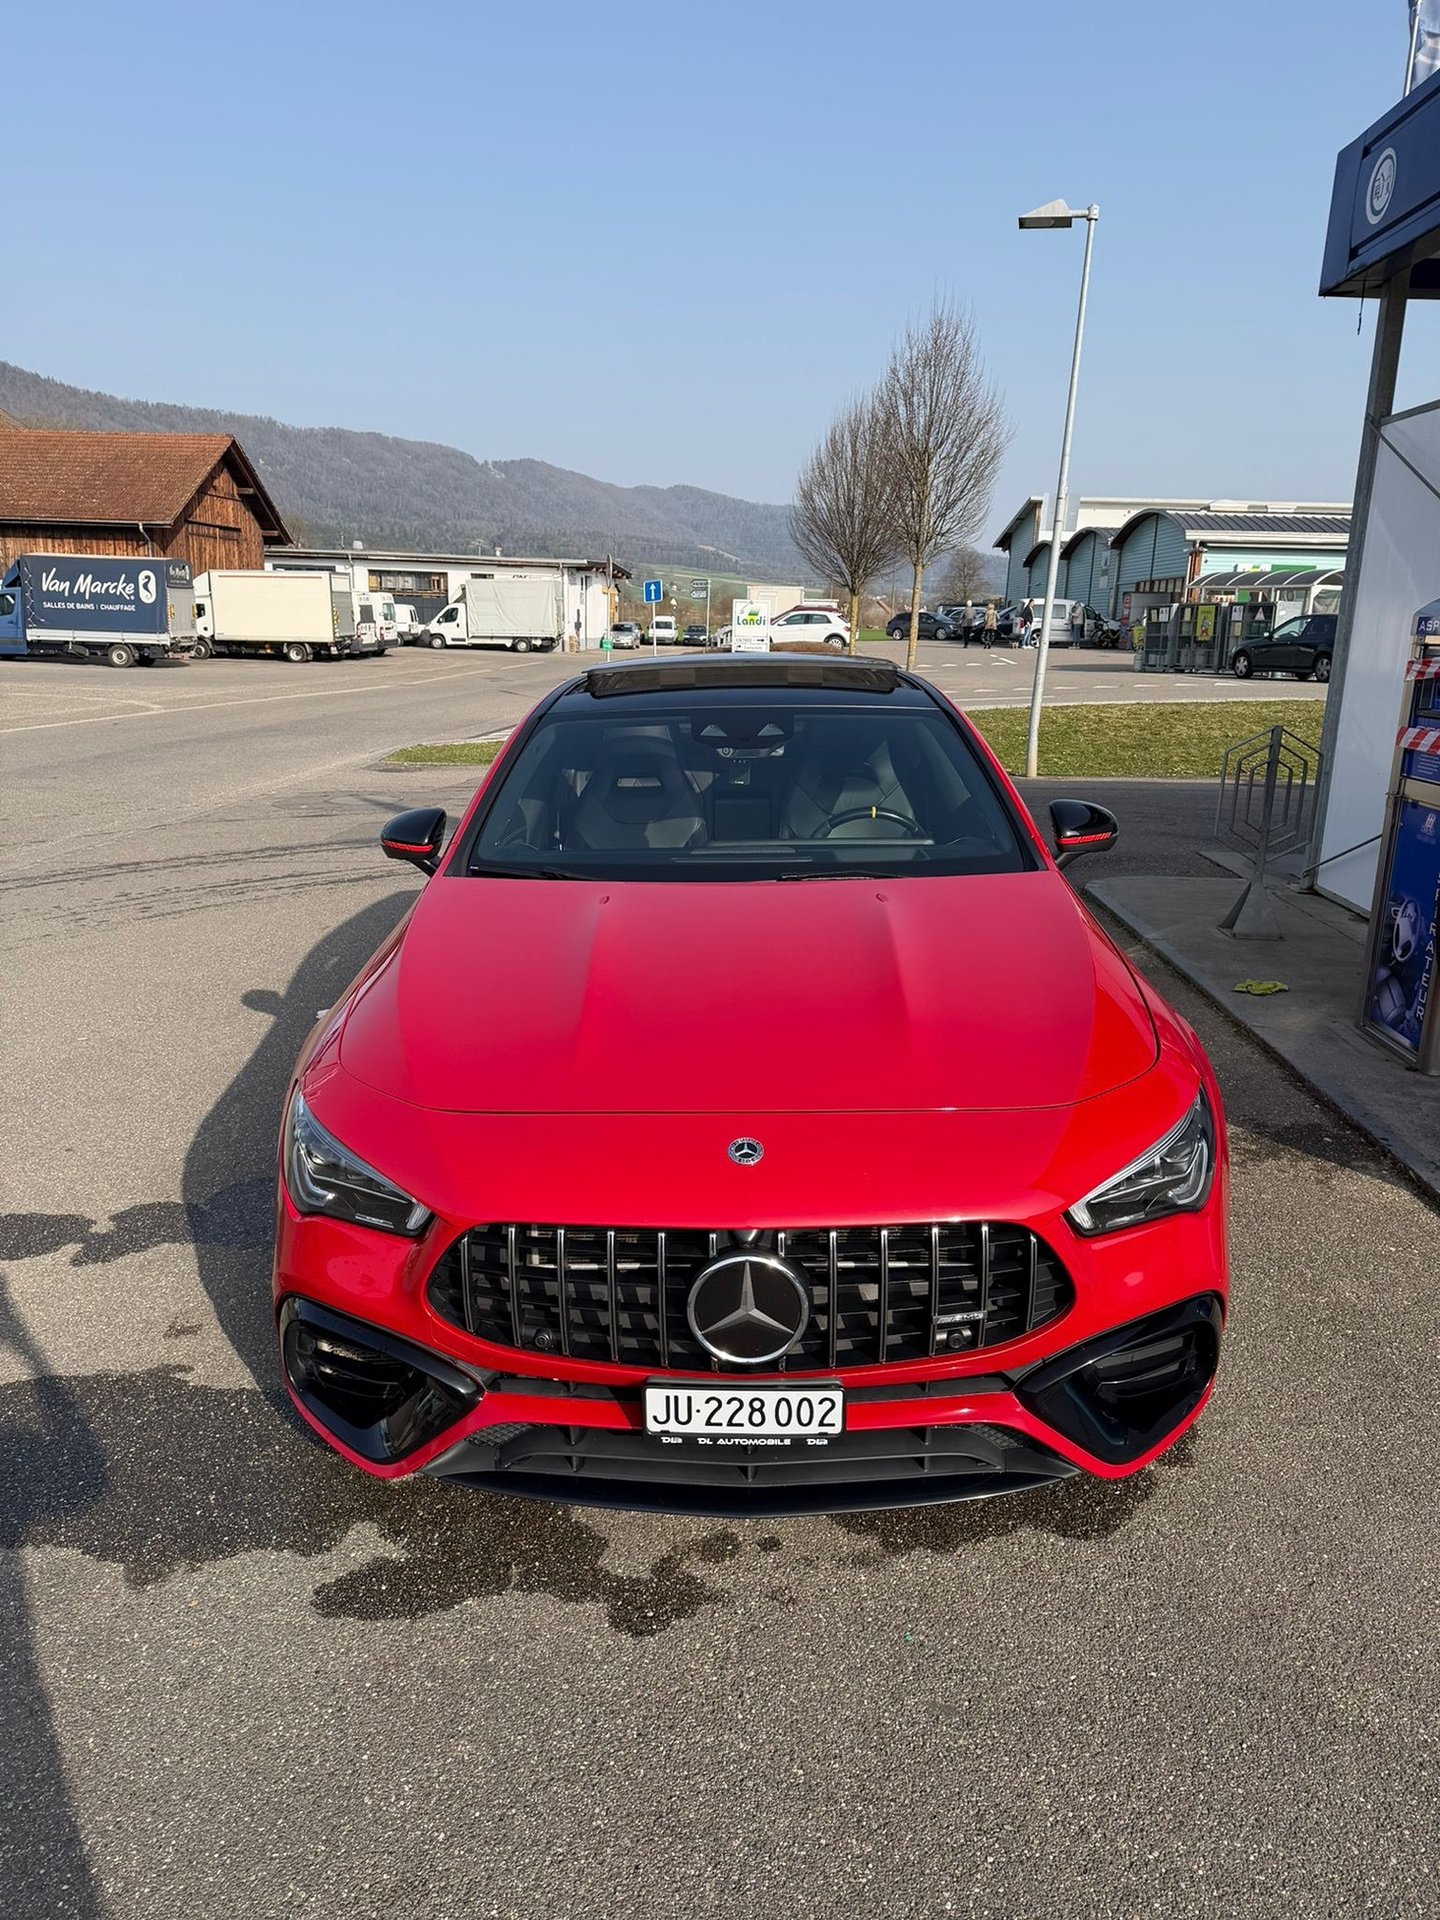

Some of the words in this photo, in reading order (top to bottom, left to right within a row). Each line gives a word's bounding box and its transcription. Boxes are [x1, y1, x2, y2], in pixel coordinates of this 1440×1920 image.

[42, 567, 70, 597] Van
[73, 573, 135, 600] Marcke
[43, 601, 66, 609] SALLES
[76, 602, 95, 610] BAINS
[100, 603, 136, 611] CHAUFFAGE
[736, 616, 766, 626] Landi
[1418, 620, 1440, 631] ASP
